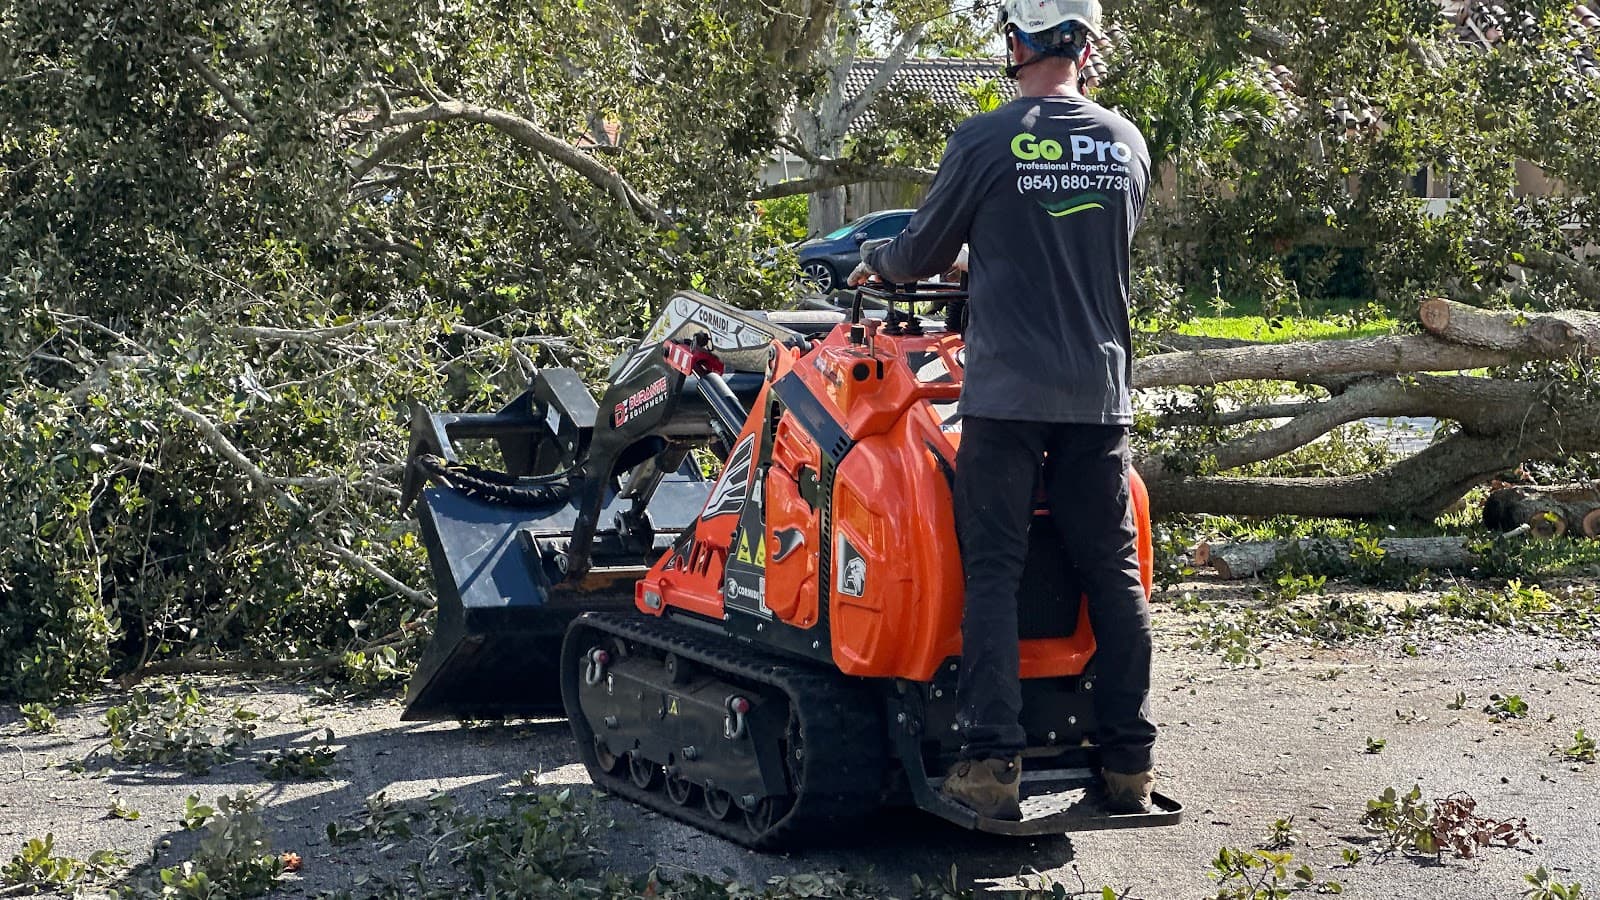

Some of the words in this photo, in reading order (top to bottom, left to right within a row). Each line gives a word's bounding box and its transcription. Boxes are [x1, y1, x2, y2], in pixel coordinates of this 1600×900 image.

[1011, 132, 1063, 161] Go
[1070, 135, 1132, 163] Pro
[1016, 162, 1069, 171] Professional
[1071, 163, 1109, 173] Property
[1017, 175, 1057, 194] (954)
[1060, 175, 1130, 191] 680-7739
[699, 309, 729, 333] CORMIDI
[629, 376, 667, 410] DURANTE
[629, 391, 668, 420] EQUIPMENT
